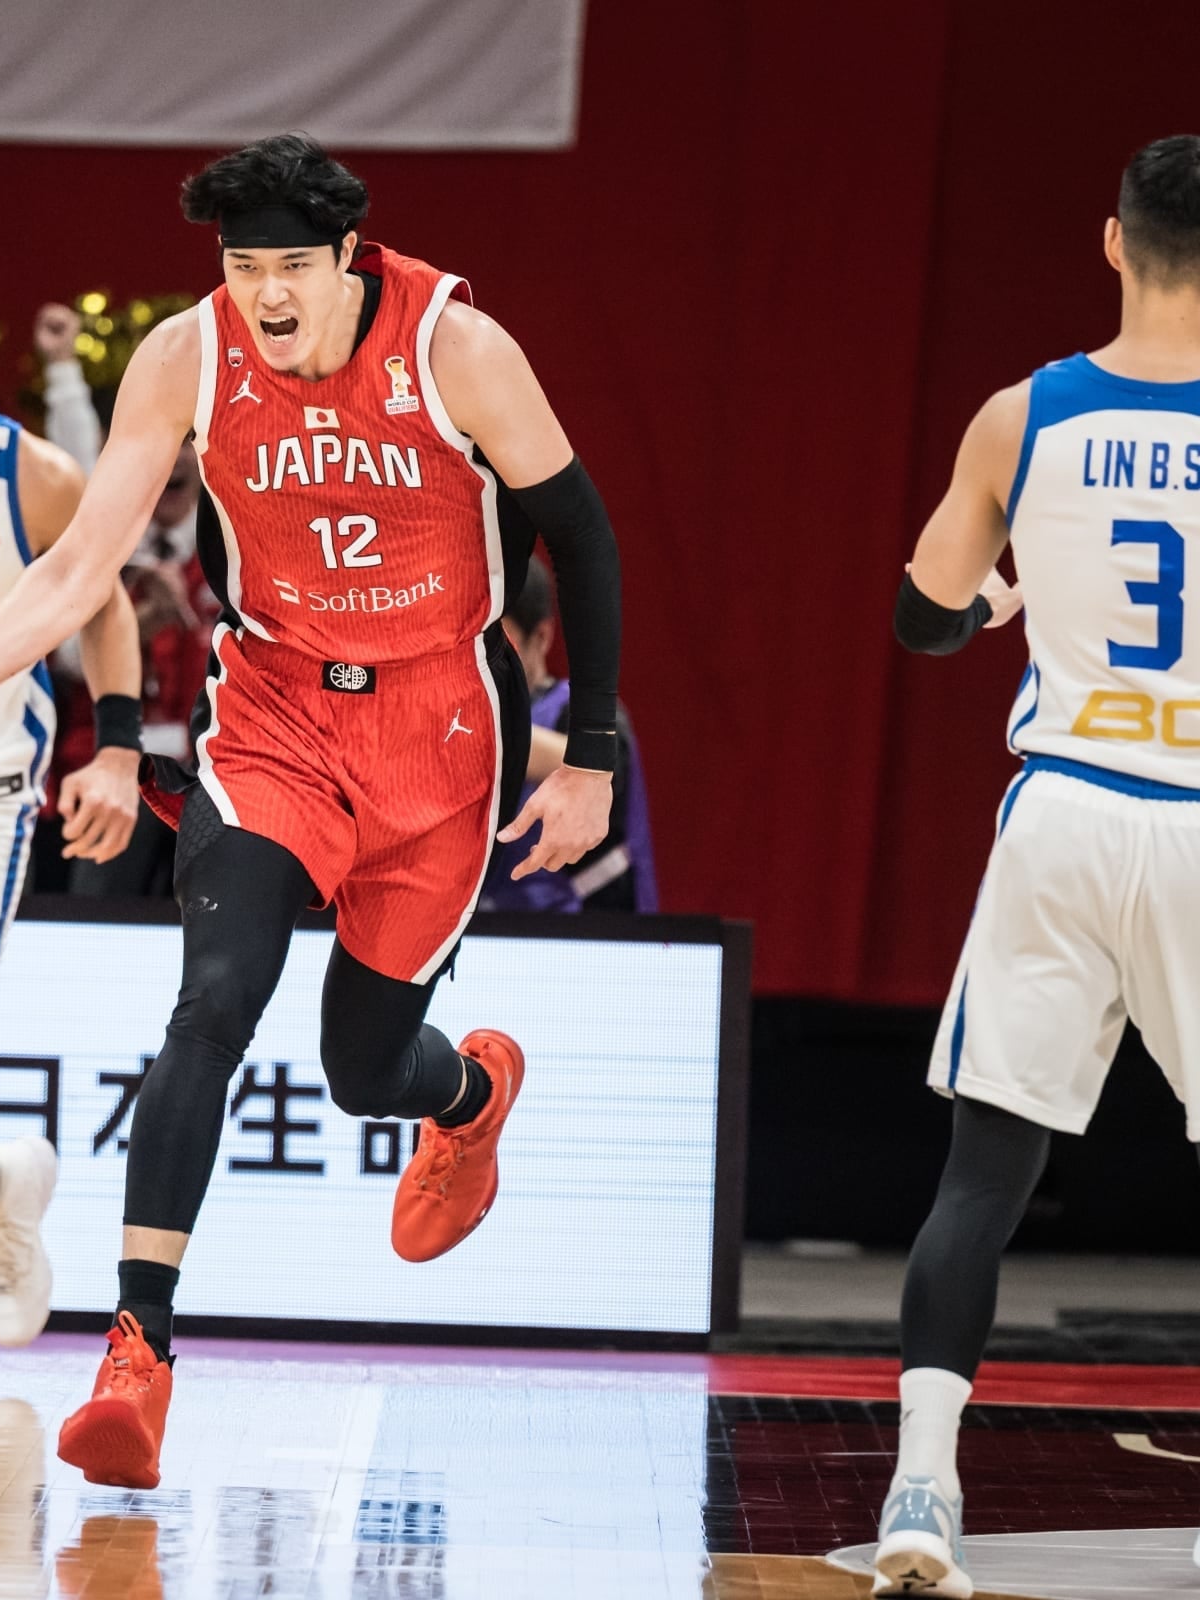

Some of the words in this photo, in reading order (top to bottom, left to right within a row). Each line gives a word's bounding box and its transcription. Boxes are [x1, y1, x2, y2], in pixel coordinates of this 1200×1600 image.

[245, 433, 424, 493] JAPAN
[1083, 438, 1137, 489] LIN
[308, 513, 384, 570] 12
[307, 571, 445, 614] SoftBank
[1106, 519, 1185, 672] 3
